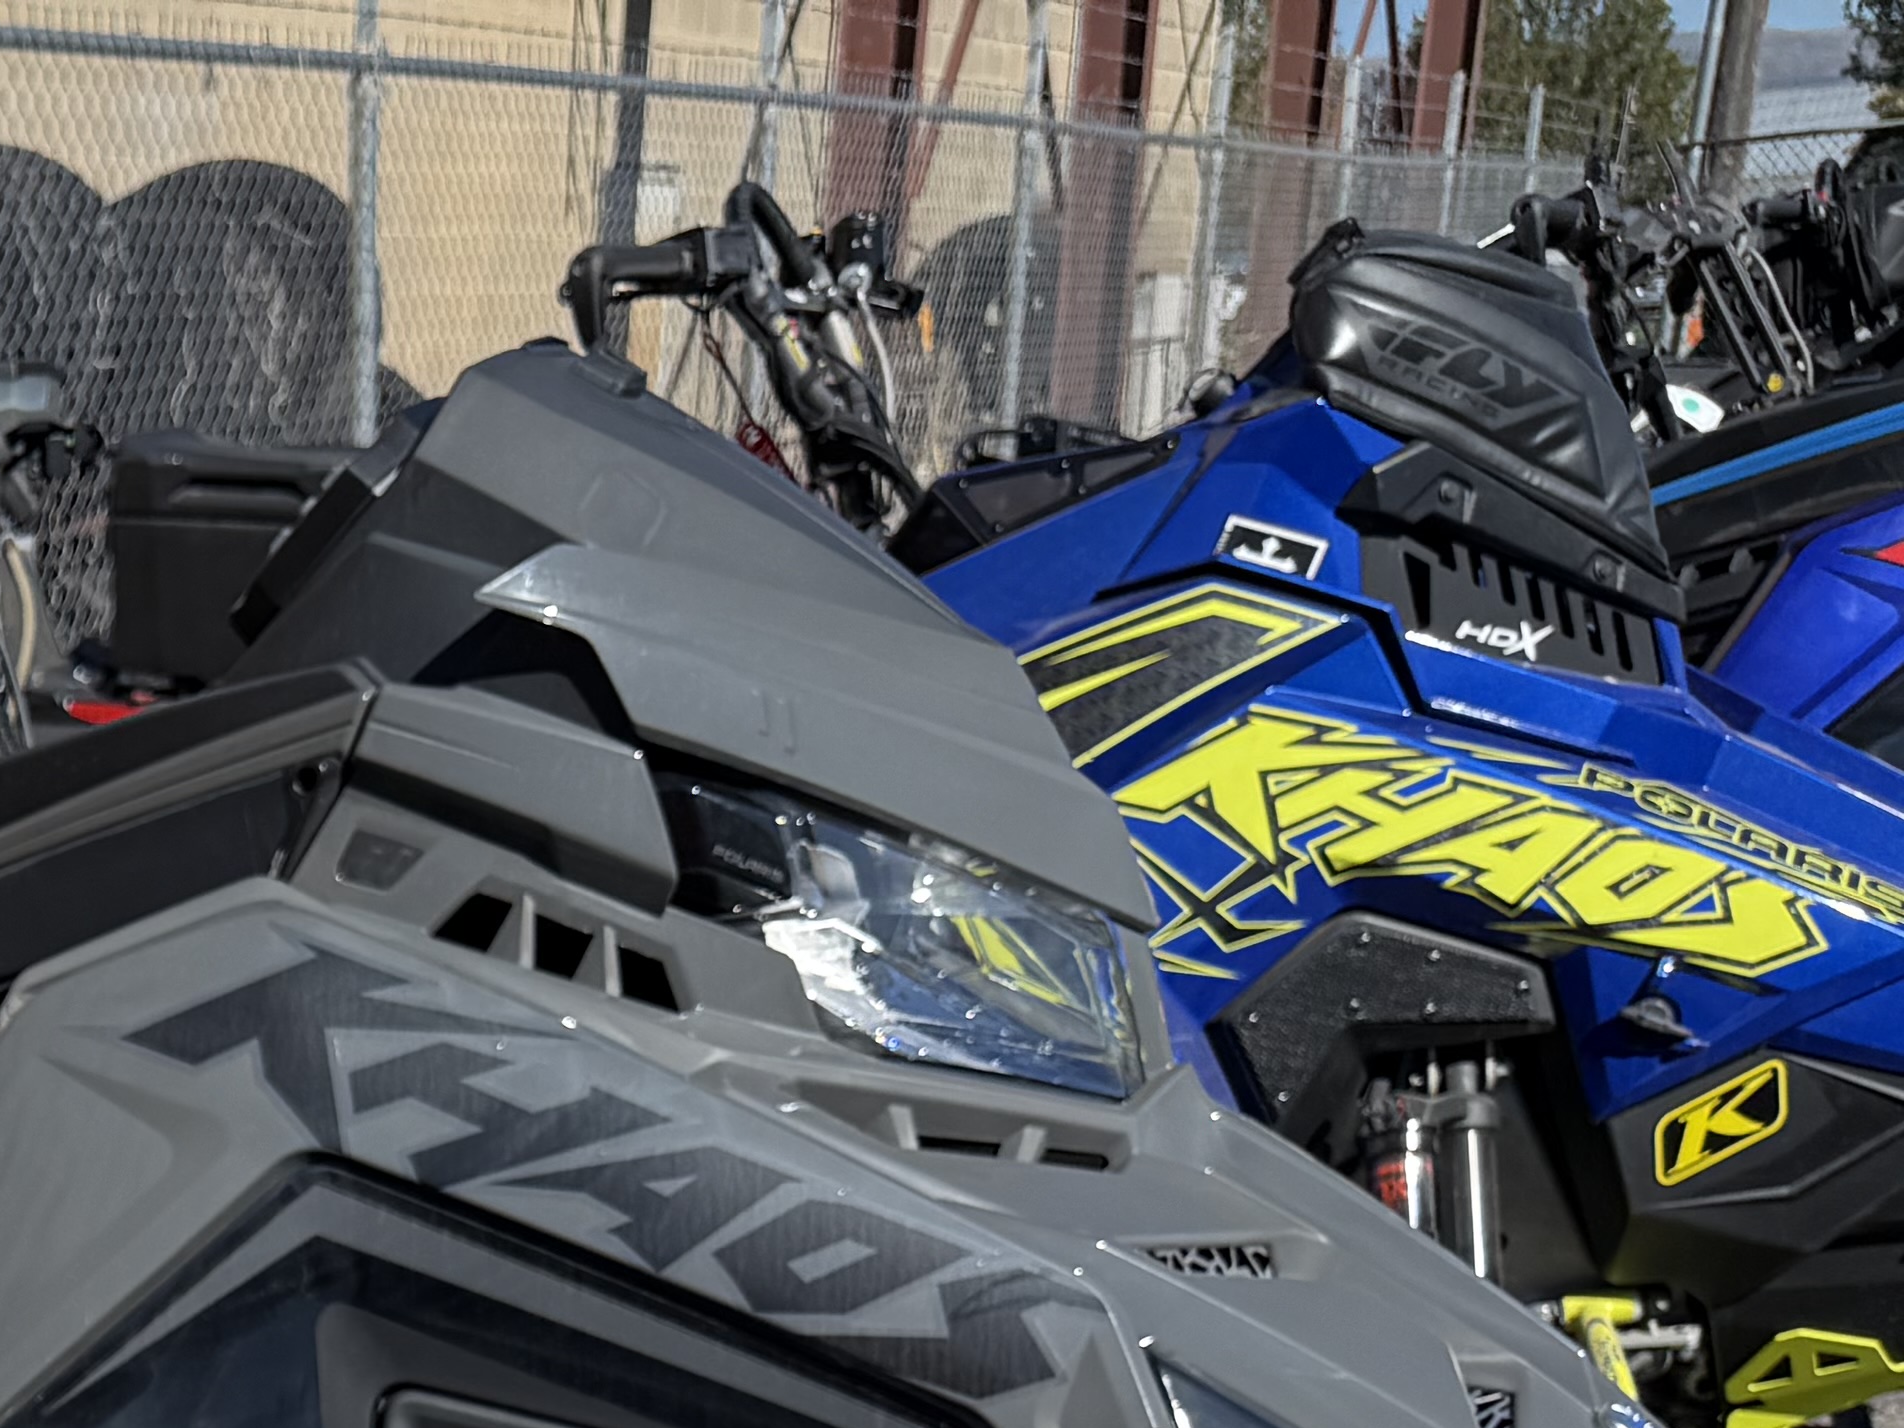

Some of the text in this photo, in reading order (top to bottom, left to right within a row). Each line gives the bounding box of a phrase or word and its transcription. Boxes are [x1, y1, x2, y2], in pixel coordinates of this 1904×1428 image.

[1370, 325, 1562, 408] FLY
[1378, 355, 1499, 418] RACING
[1455, 620, 1556, 662] HDX
[1111, 703, 1830, 977] KHAOS
[119, 930, 1100, 1398] KHAOS
